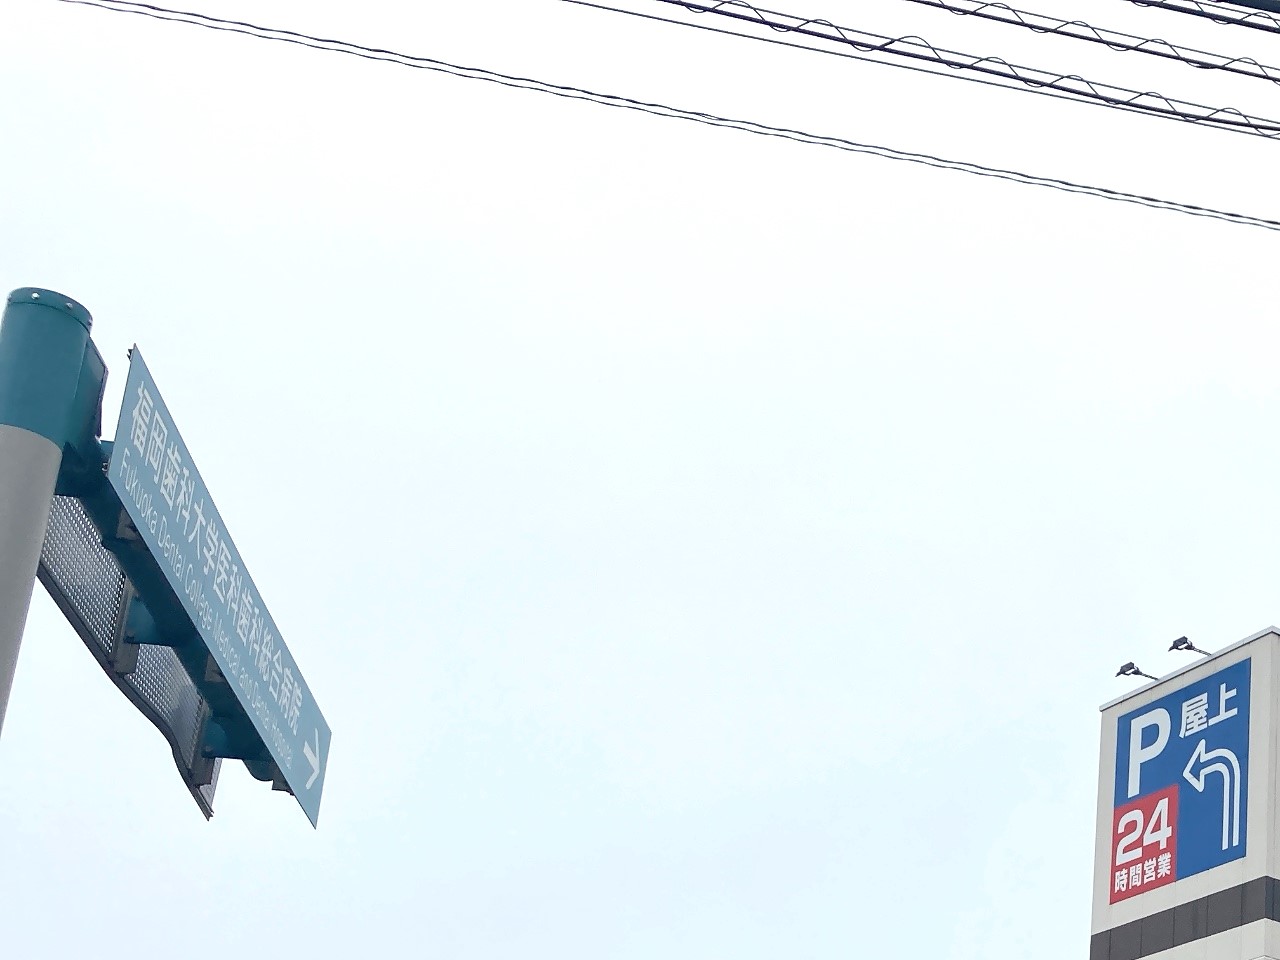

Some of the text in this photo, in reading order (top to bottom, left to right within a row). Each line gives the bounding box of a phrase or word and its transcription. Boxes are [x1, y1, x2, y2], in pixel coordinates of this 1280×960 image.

[119, 447, 158, 537] Fukuoka
[158, 515, 187, 582] Dental
[185, 564, 214, 631] College
[131, 381, 303, 736] 福岡歯科大学医科歯科総合病院
[1127, 682, 1238, 799] P 屋上
[1114, 852, 1172, 893] 時間営業
[1115, 797, 1172, 866] 24
